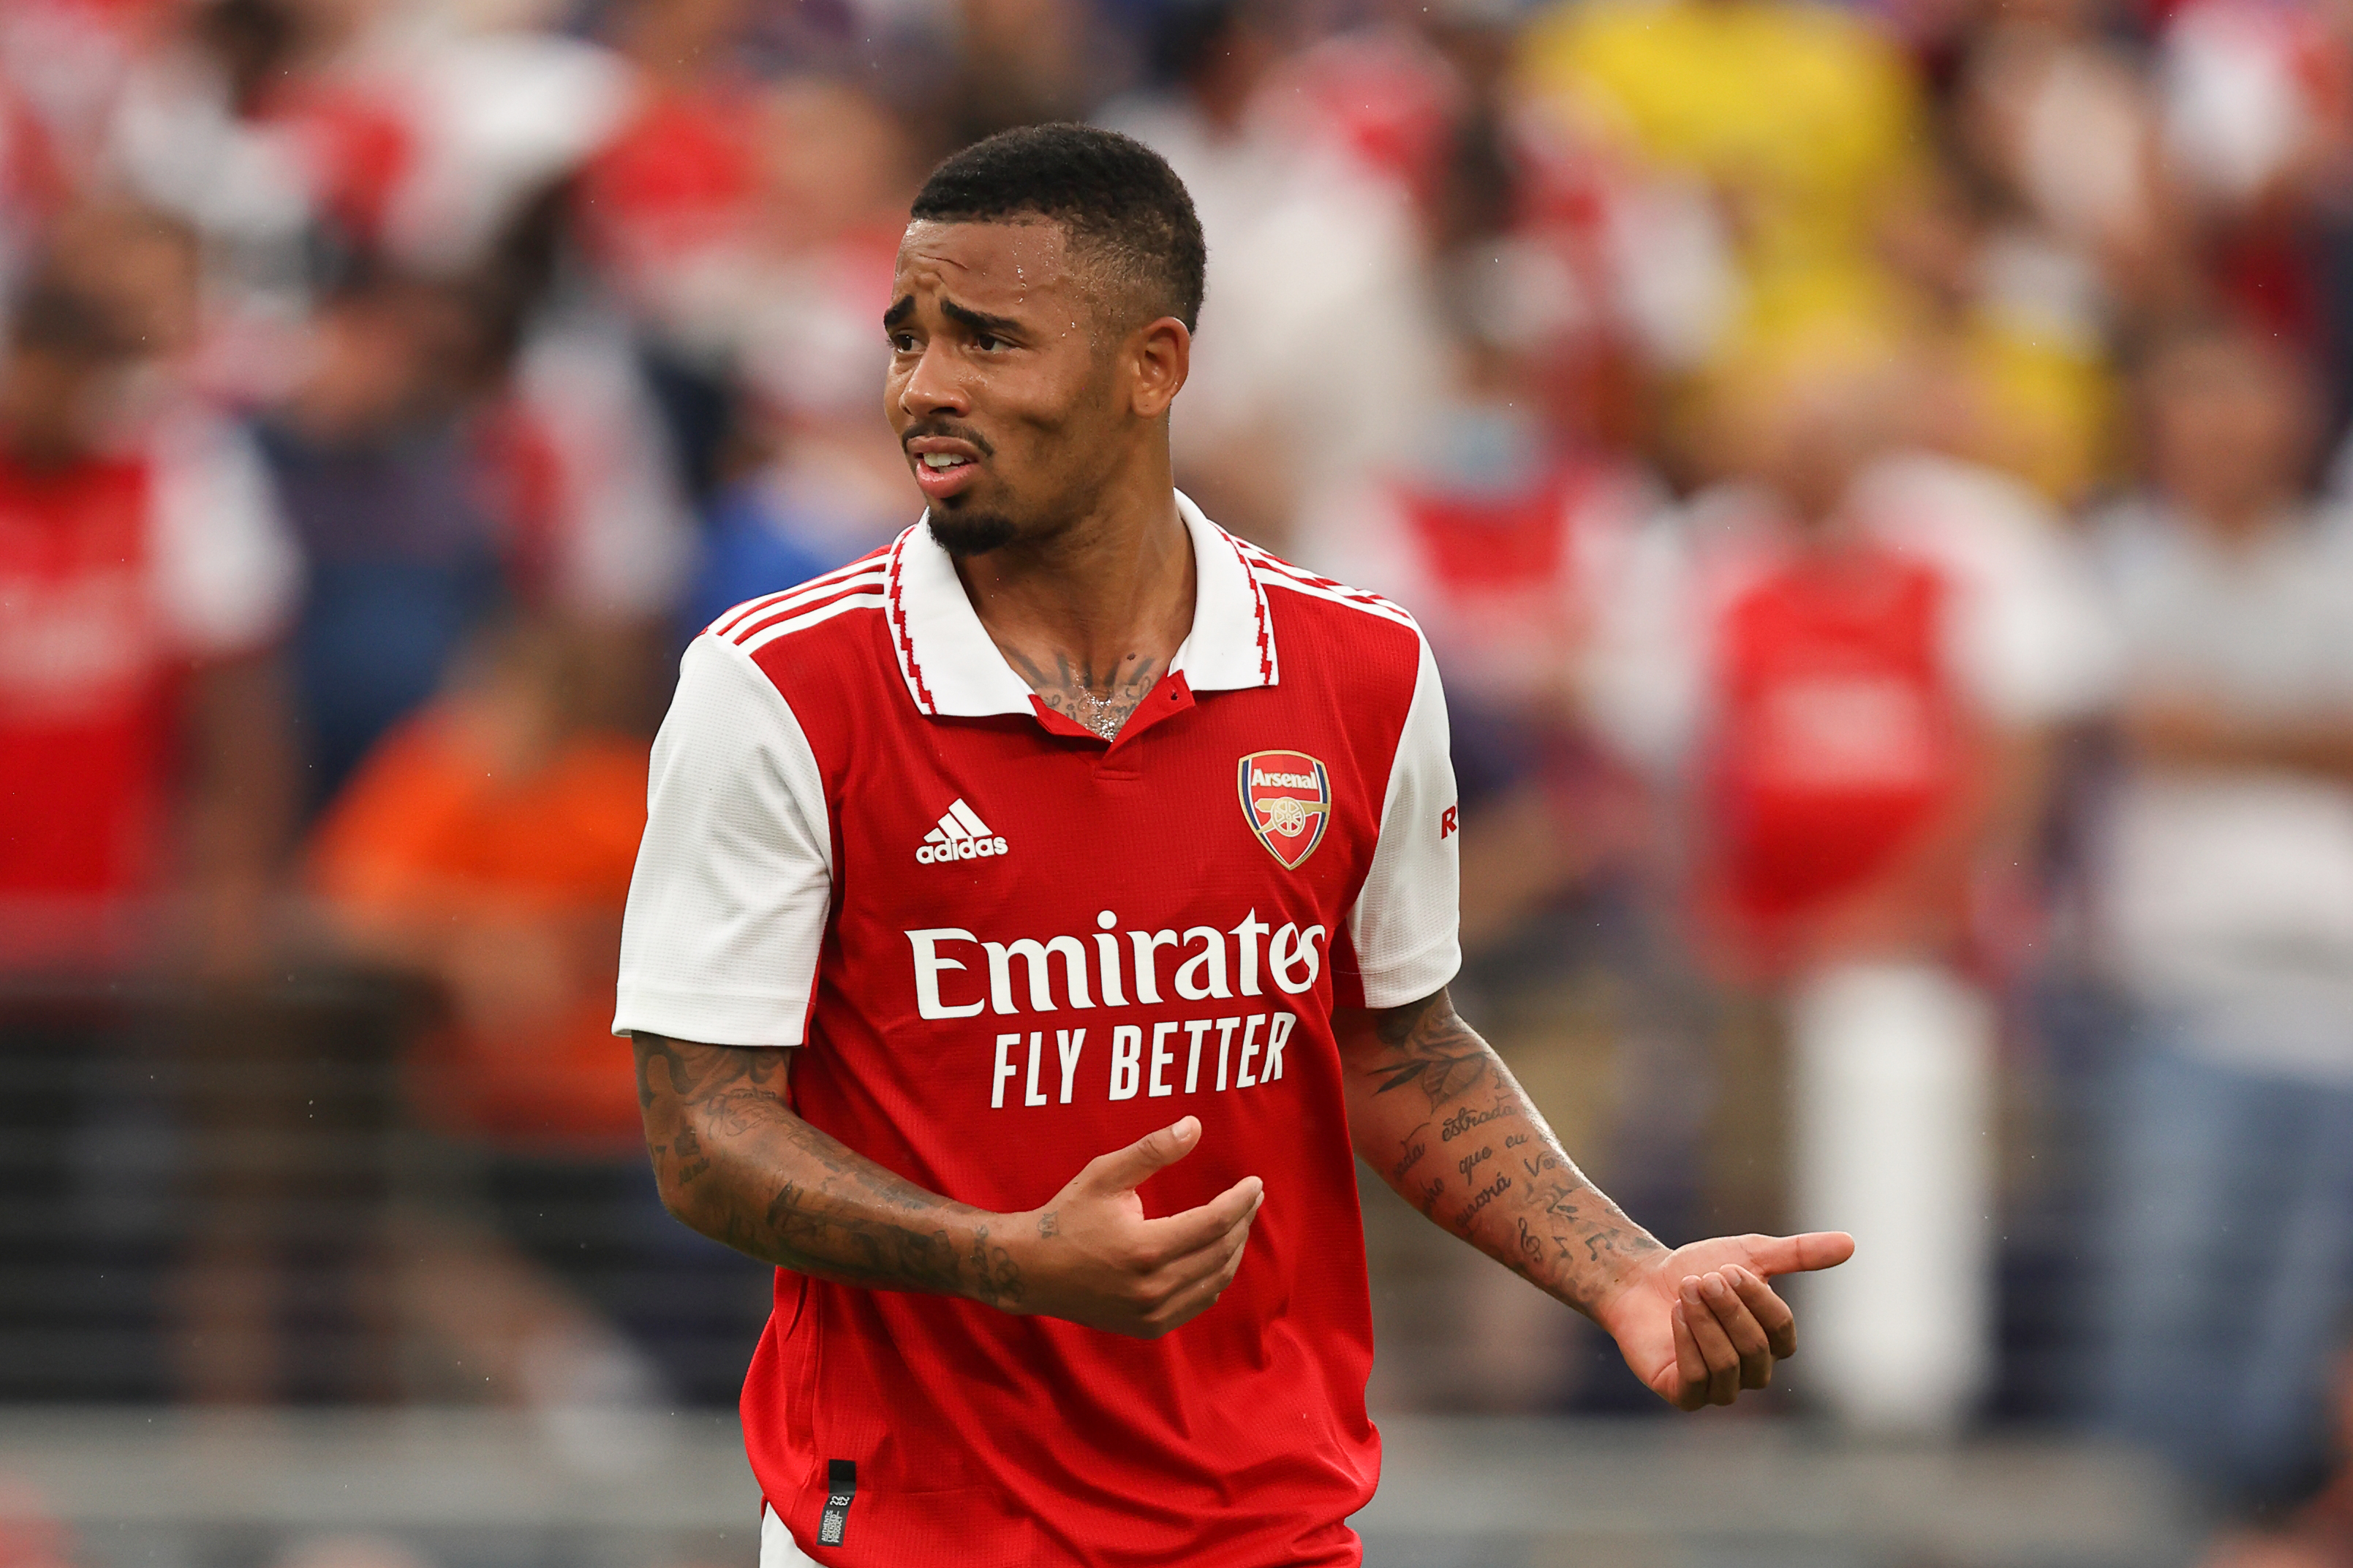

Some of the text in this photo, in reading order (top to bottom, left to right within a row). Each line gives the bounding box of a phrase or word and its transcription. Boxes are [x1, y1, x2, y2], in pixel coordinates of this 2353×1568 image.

[1251, 768, 1318, 790] Arsenal
[1440, 803, 1458, 840] R
[915, 836, 1008, 865] adidas
[904, 906, 1326, 1020] Emirates
[991, 1012, 1297, 1109] FLY BETTER
[1458, 1134, 1529, 1186] que eu
[821, 1510, 834, 1542] AUTHENTIC
[833, 1516, 842, 1543] PRODUCT
